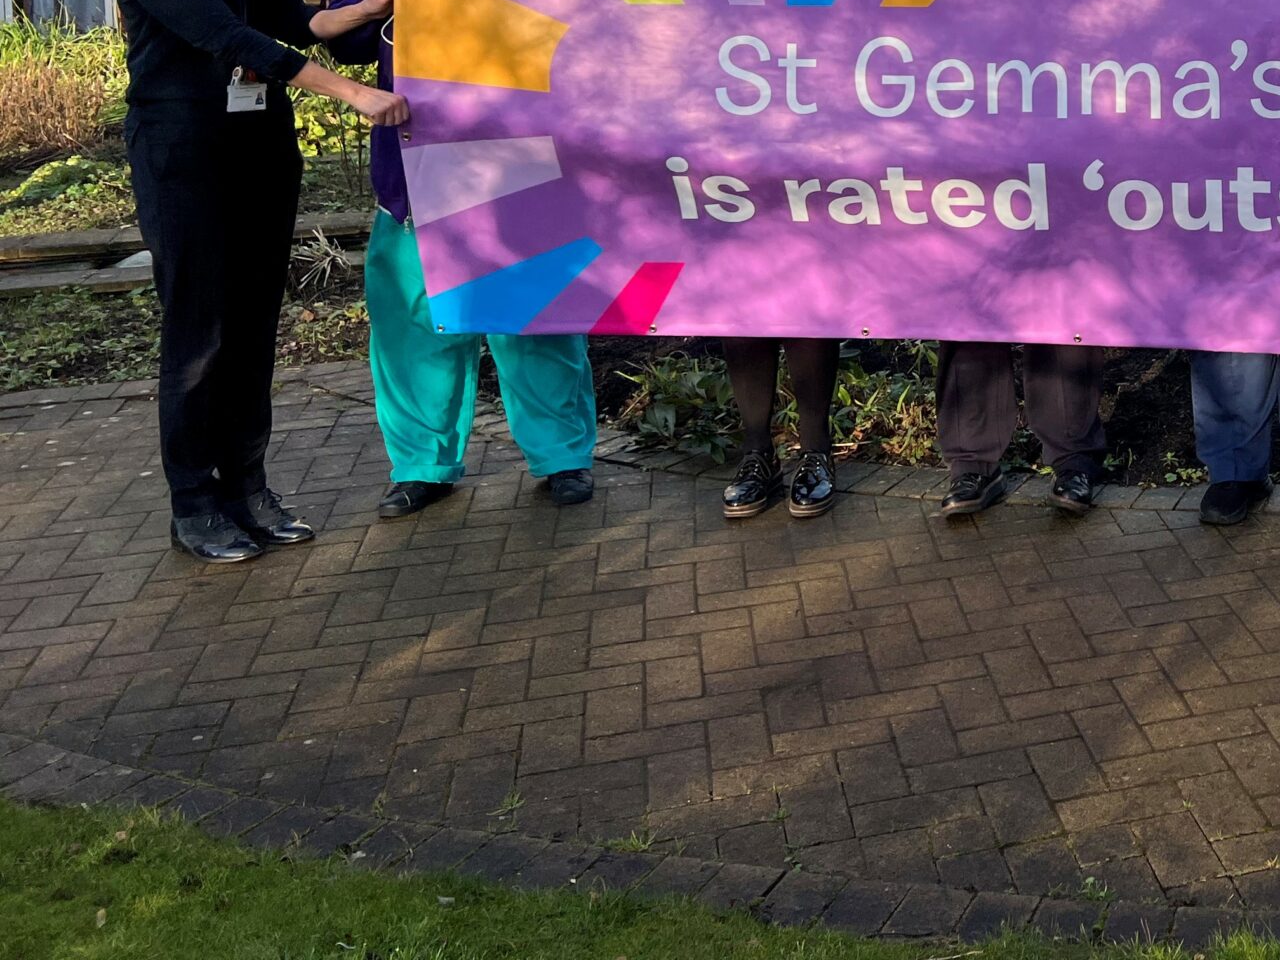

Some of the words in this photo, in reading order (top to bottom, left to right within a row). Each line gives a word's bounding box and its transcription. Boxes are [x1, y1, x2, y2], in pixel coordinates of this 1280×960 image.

[715, 35, 818, 116] St
[665, 156, 756, 223] is
[783, 162, 1050, 232] rated
